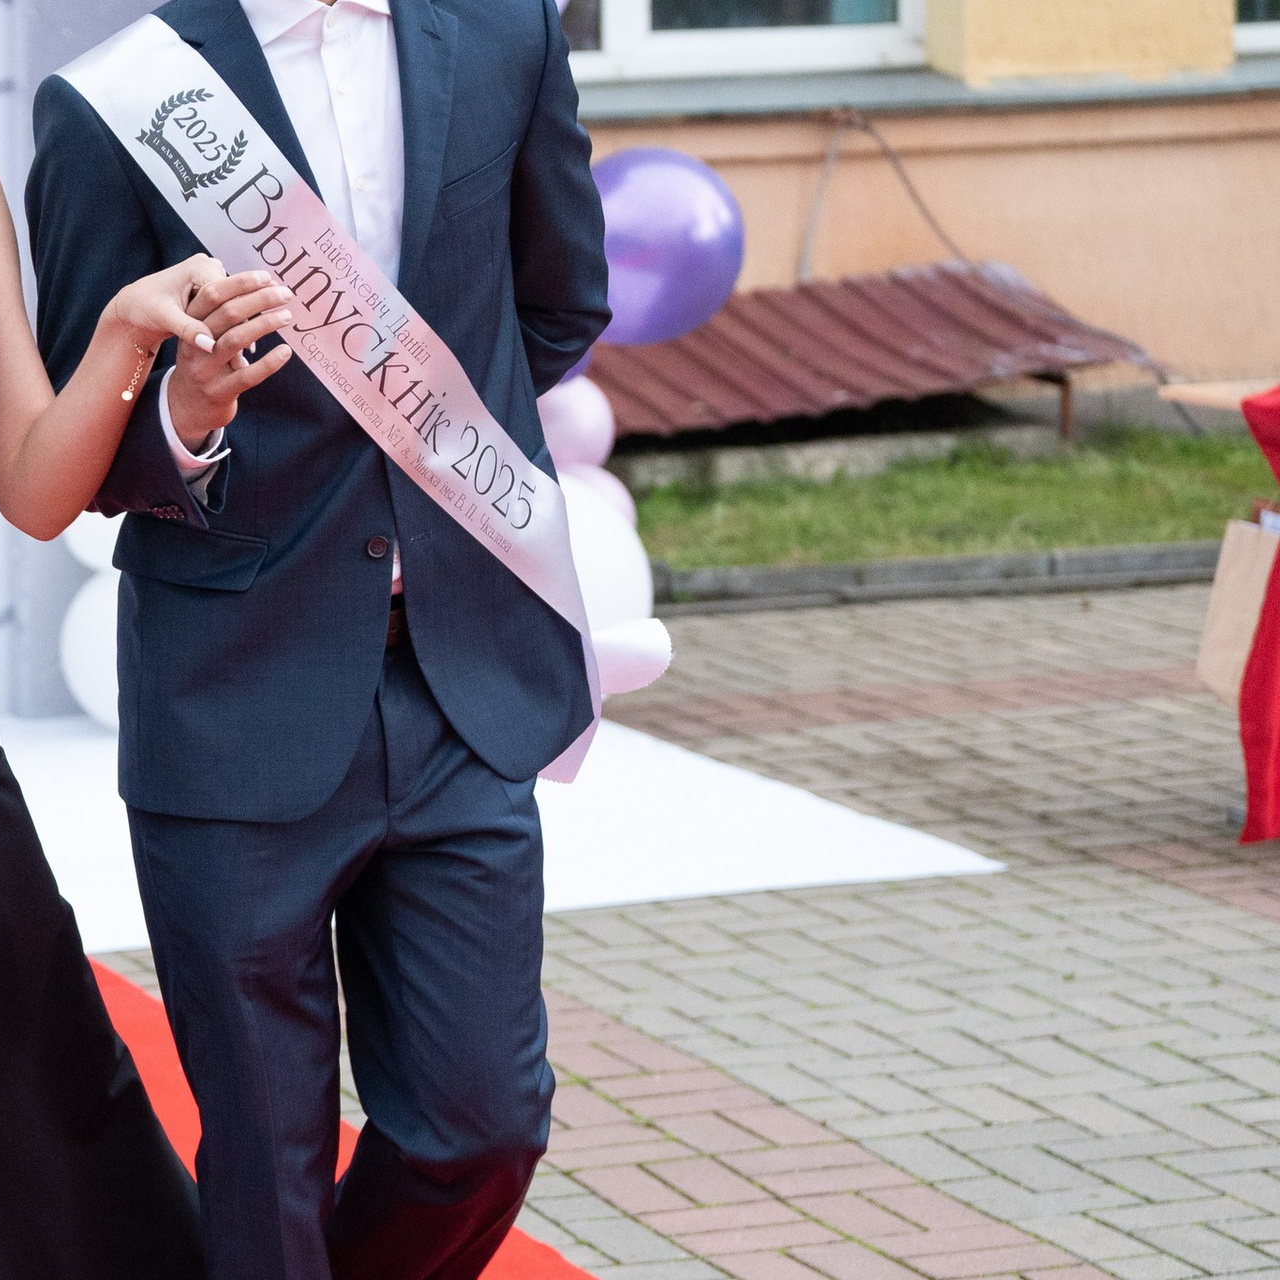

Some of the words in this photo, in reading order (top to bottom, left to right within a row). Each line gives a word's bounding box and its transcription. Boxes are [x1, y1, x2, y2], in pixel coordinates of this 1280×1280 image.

[173, 107, 227, 161] 2025
[173, 158, 191, 183] КЛАС
[216, 162, 451, 456] Выпускнік
[451, 420, 537, 530] 2025
[314, 228, 391, 319] Гайдукевіч
[384, 314, 431, 365] Данііл
[300, 332, 354, 396] Сярэдняя
[351, 394, 384, 429] школа
[410, 452, 442, 489] Мінска
[439, 481, 456, 502] імя
[480, 513, 513, 554] Чкалава
